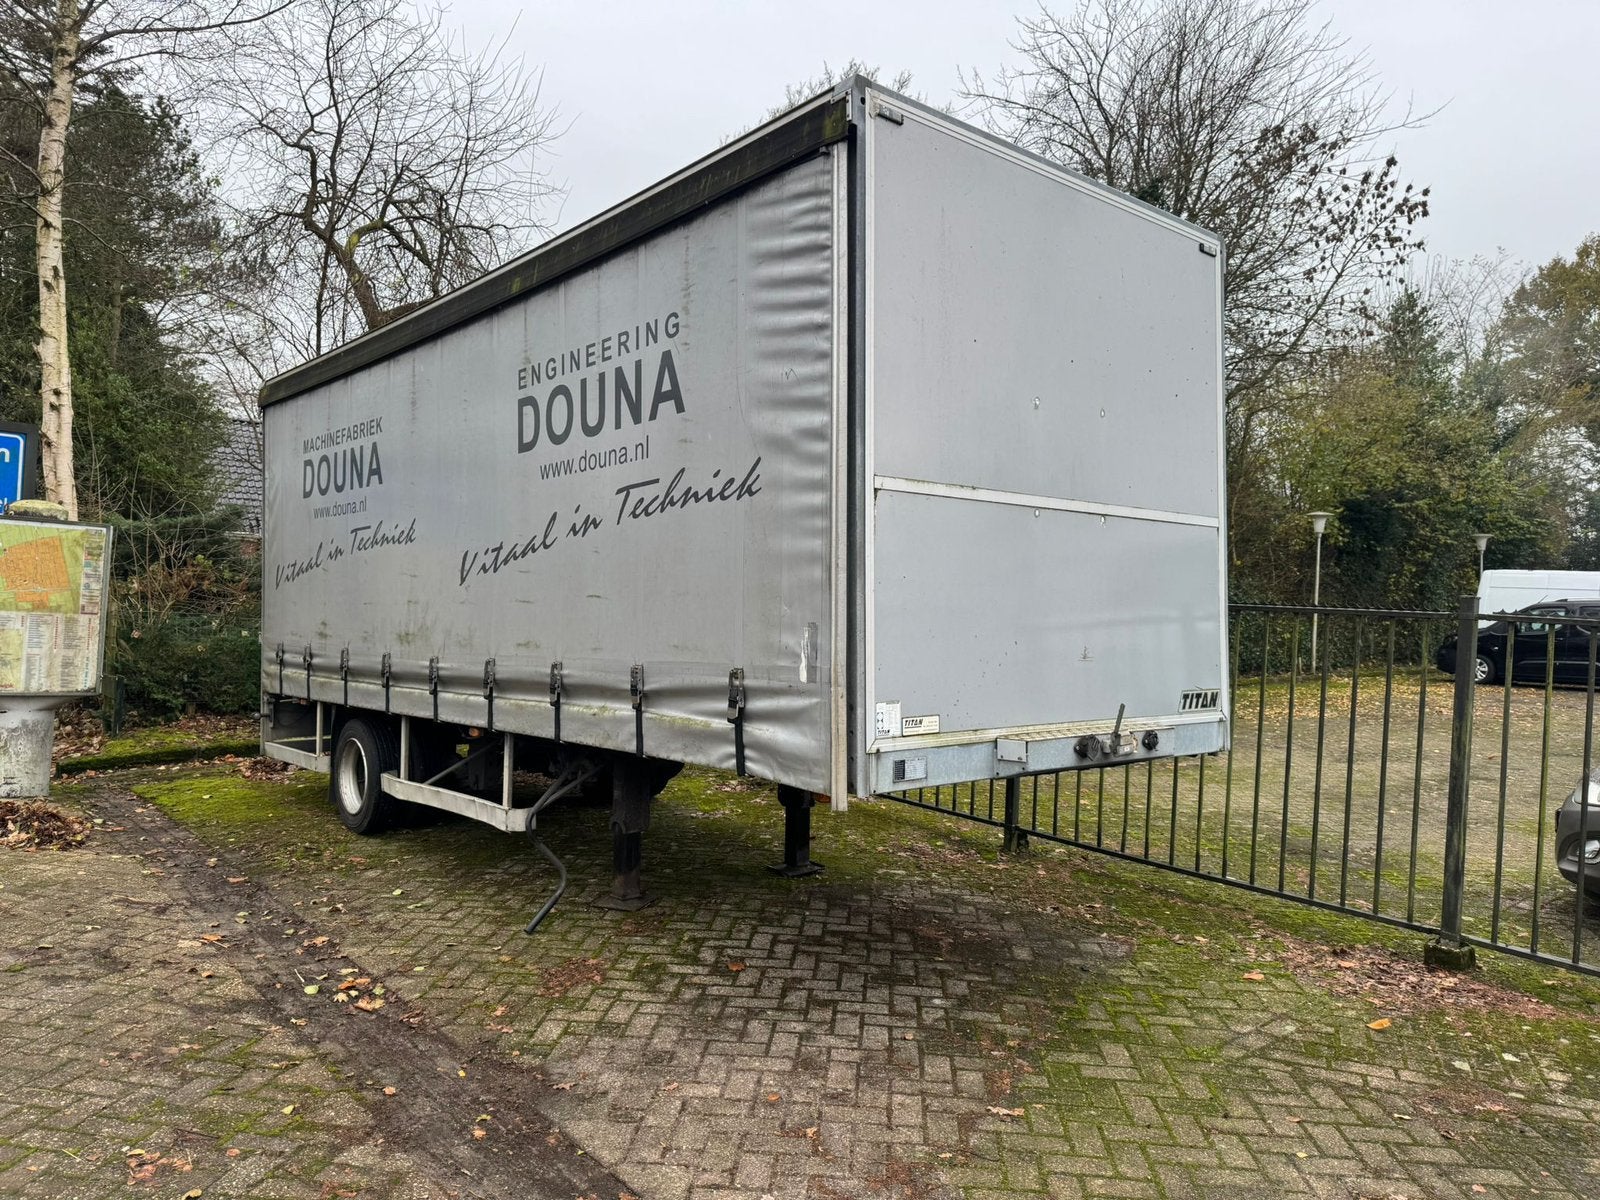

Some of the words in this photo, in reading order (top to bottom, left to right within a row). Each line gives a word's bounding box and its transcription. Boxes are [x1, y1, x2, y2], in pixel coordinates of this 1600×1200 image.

[517, 312, 681, 390] ENGINEERING
[517, 349, 687, 454] DOUNA
[303, 416, 383, 454] MACHINEFABRIEK
[539, 435, 650, 480] www.douna.nl
[302, 441, 384, 499] DOUNA
[312, 496, 367, 520] www.douna.nl
[459, 511, 558, 587] Vitaal
[566, 504, 603, 538] in
[615, 456, 762, 526] Techniek
[275, 541, 324, 591] Vitaal
[326, 538, 345, 562] in
[350, 517, 417, 555] Techniek
[904, 718, 923, 727] TITAN
[1181, 690, 1219, 710] TITAN
